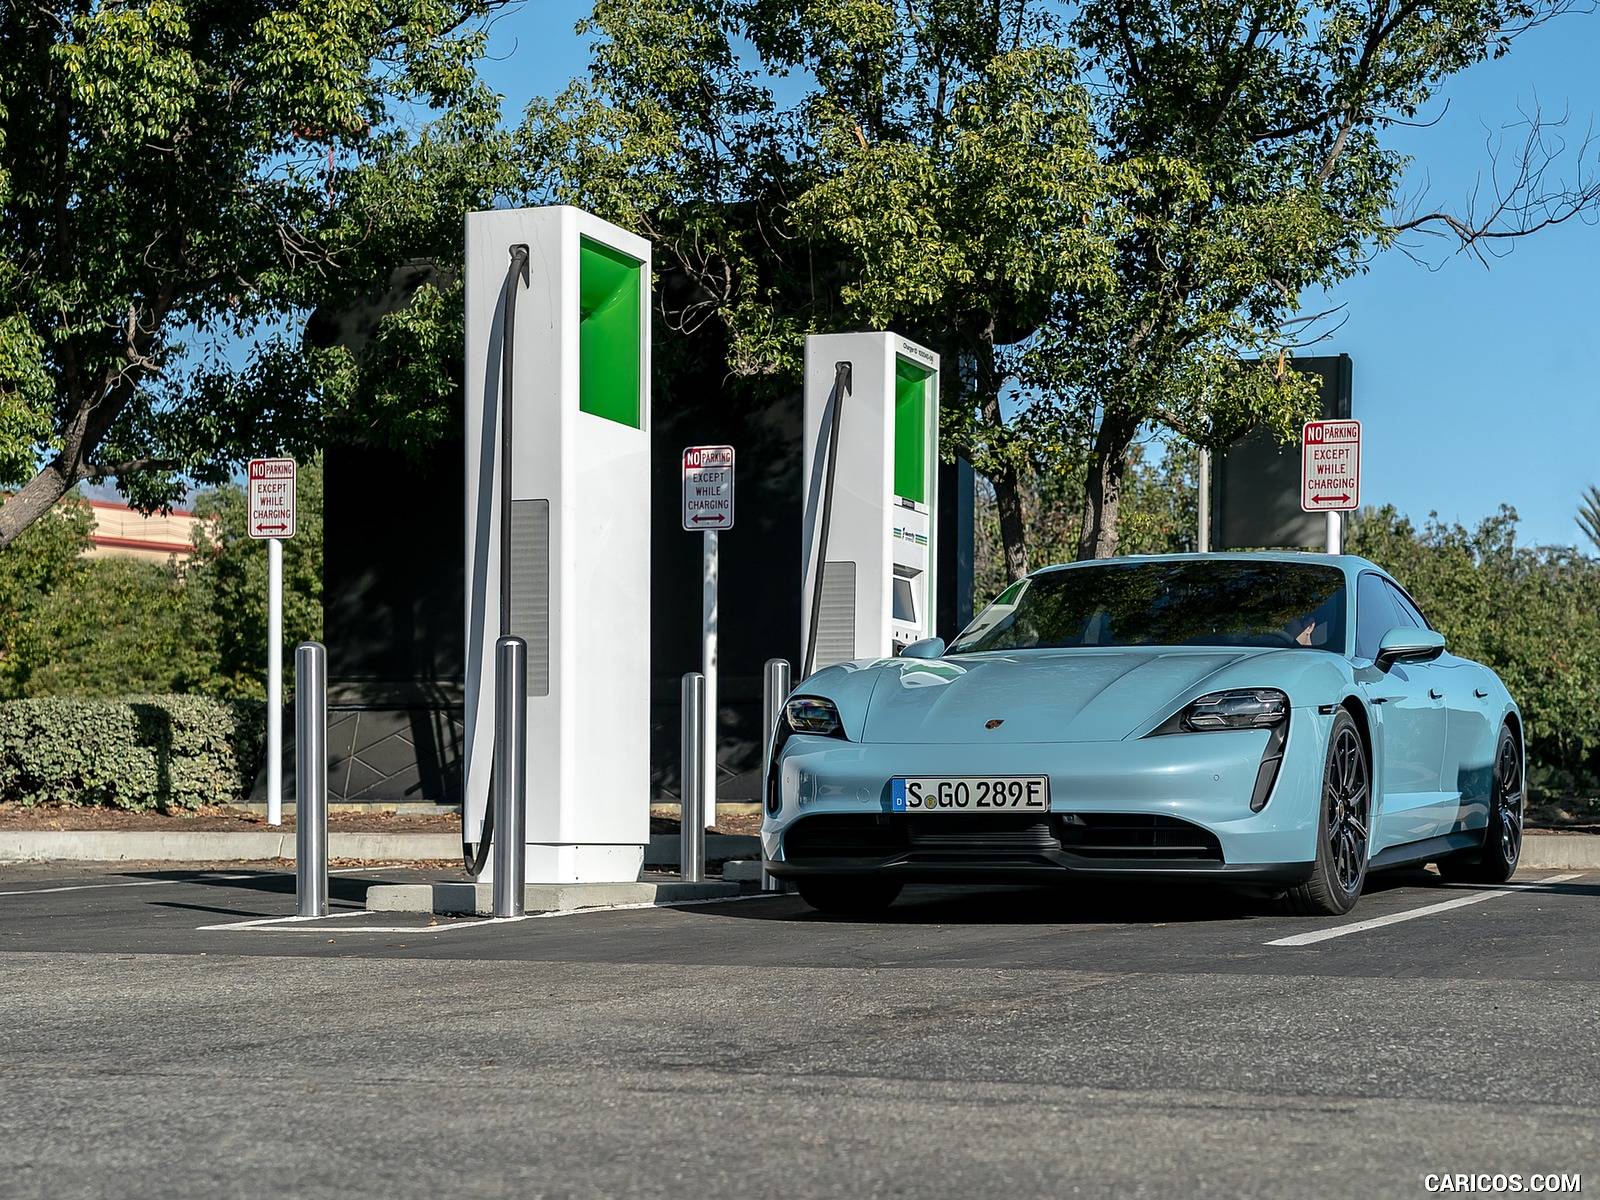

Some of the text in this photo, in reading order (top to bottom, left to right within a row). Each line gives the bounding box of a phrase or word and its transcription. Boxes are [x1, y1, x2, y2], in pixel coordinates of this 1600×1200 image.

[1308, 426, 1357, 441] NO PARKING
[687, 452, 731, 466] NO PARKING
[1314, 448, 1350, 460] EXCEPT
[252, 463, 292, 477] NO PARKING
[1316, 463, 1346, 475] WHILE
[693, 472, 724, 483] EXCEPT
[257, 483, 287, 494] EXCEPT
[1308, 478, 1355, 490] CHARGING
[695, 486, 721, 497] WHILE
[260, 496, 284, 506] WHILE
[687, 499, 729, 511] CHARGING
[253, 509, 291, 520] CHARGING
[908, 781, 1043, 808] S GO 289E
